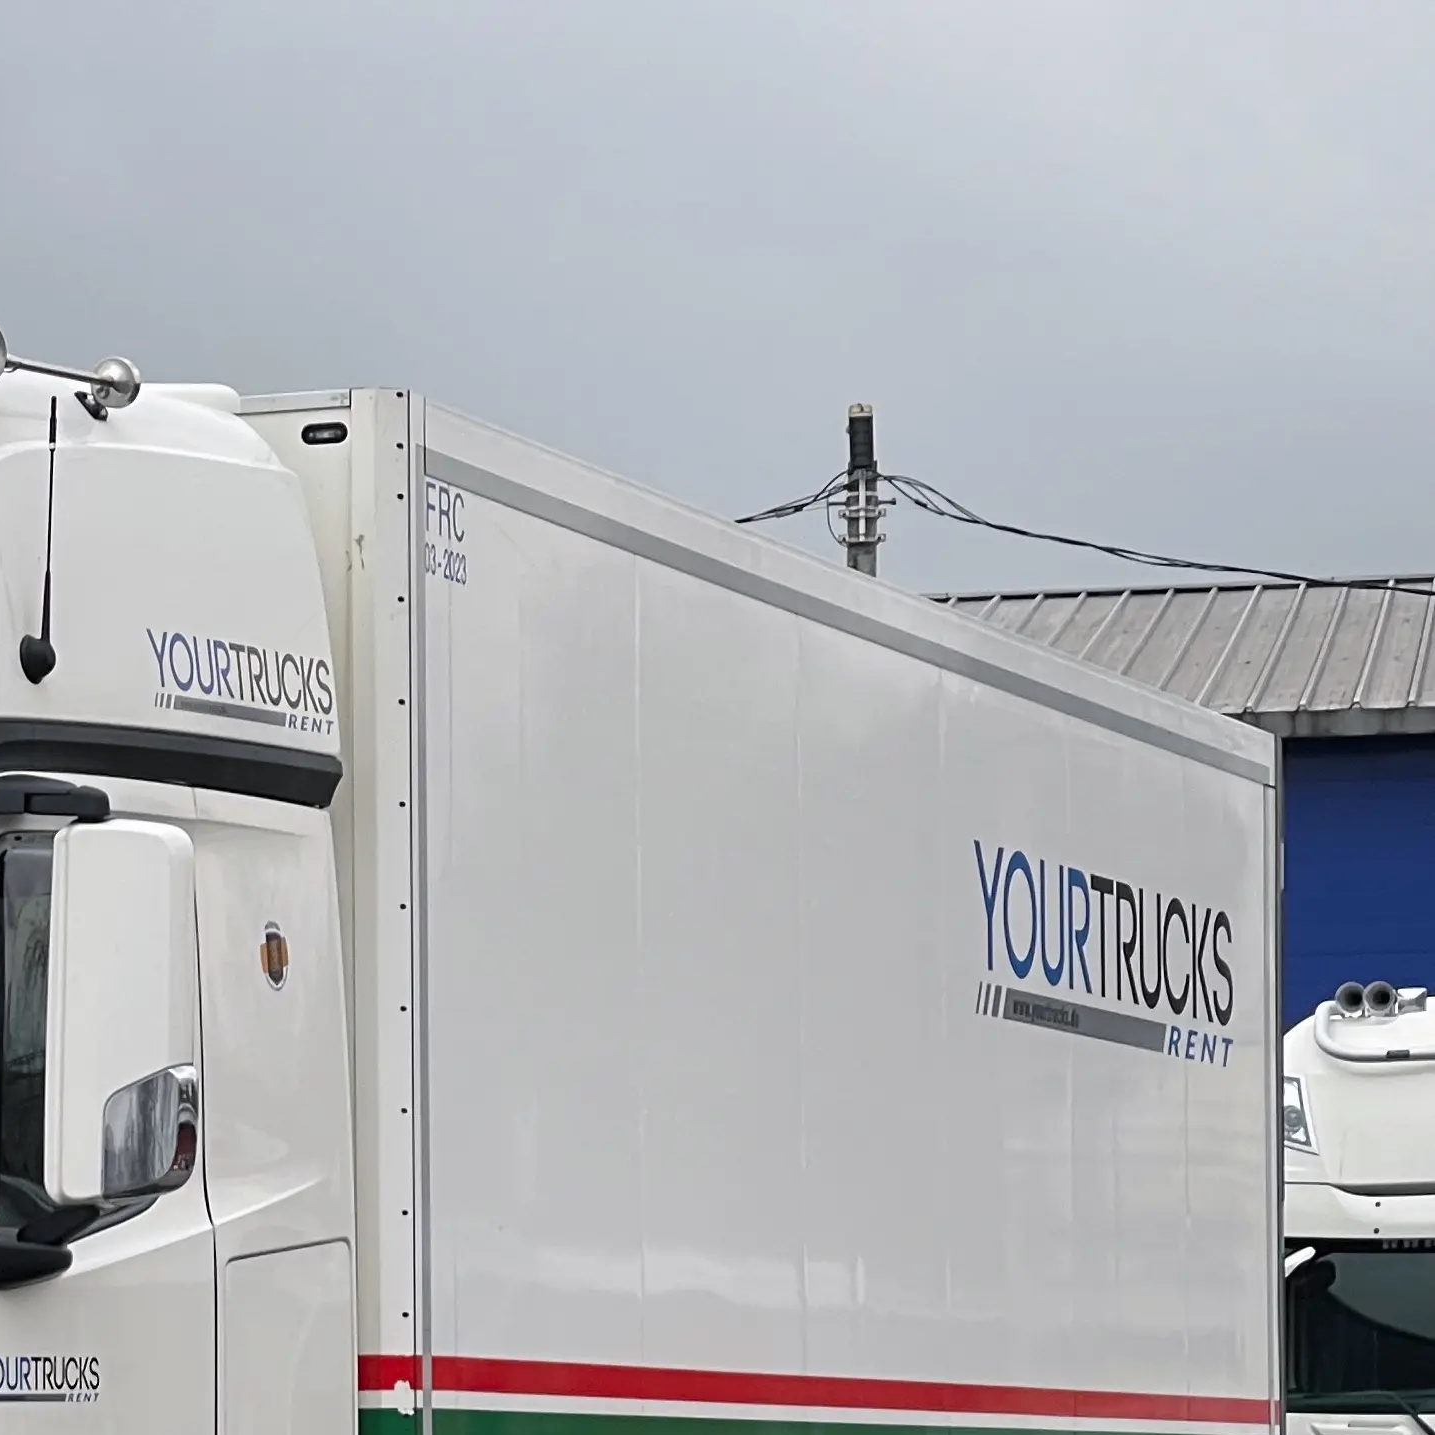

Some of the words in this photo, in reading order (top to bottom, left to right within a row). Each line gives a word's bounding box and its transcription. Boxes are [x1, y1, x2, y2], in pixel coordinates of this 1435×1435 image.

[425, 481, 465, 542] FRC
[424, 542, 467, 586] 03-2023
[145, 627, 333, 716] YOURTRUCKS
[288, 713, 335, 736] RENT
[973, 838, 1234, 1027] YOURTRUCKS
[1167, 1024, 1234, 1068] RENT
[67, 1393, 100, 1403] RENT
